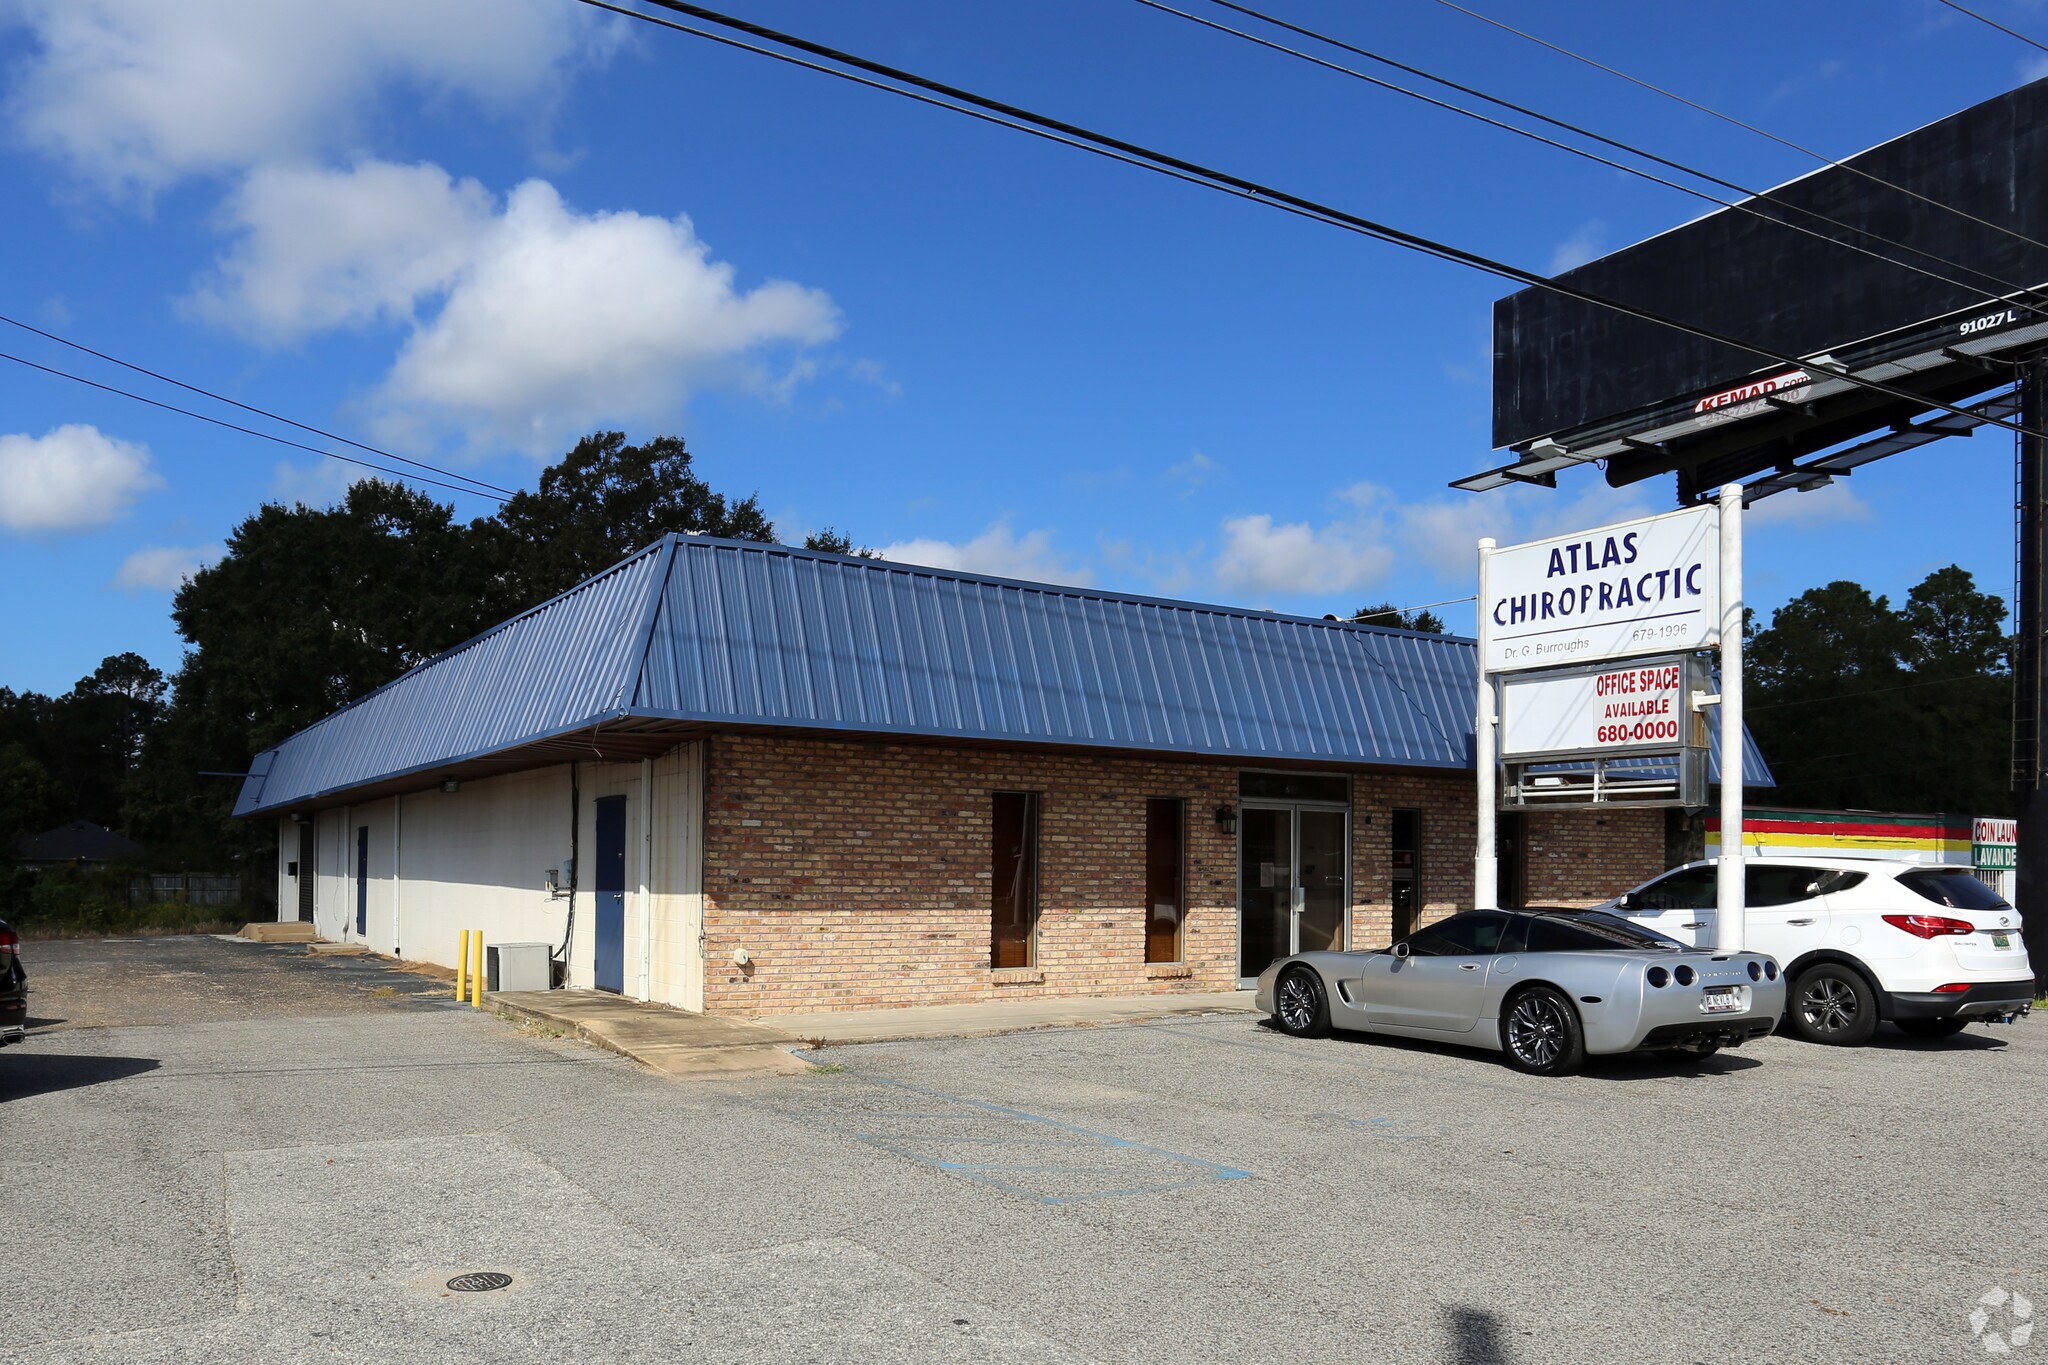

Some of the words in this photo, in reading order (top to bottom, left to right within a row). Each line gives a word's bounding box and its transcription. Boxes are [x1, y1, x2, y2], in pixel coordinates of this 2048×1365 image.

[1959, 311, 2006, 335] 91027
[2006, 310, 2016, 323] L
[1547, 532, 1638, 578] ATLAS
[1493, 563, 1702, 626] CHIROPRACTIC
[1632, 623, 1688, 642] 679-1996
[1504, 647, 1518, 659] Dr.
[1521, 645, 1533, 657] G.
[1536, 638, 1590, 655] Burroughs
[1596, 671, 1636, 697] OFFICE
[1639, 666, 1679, 692] SPACE
[1604, 698, 1669, 719] AVAILABLE
[1597, 720, 1678, 743] 680-0000
[1975, 821, 1996, 842] COIN
